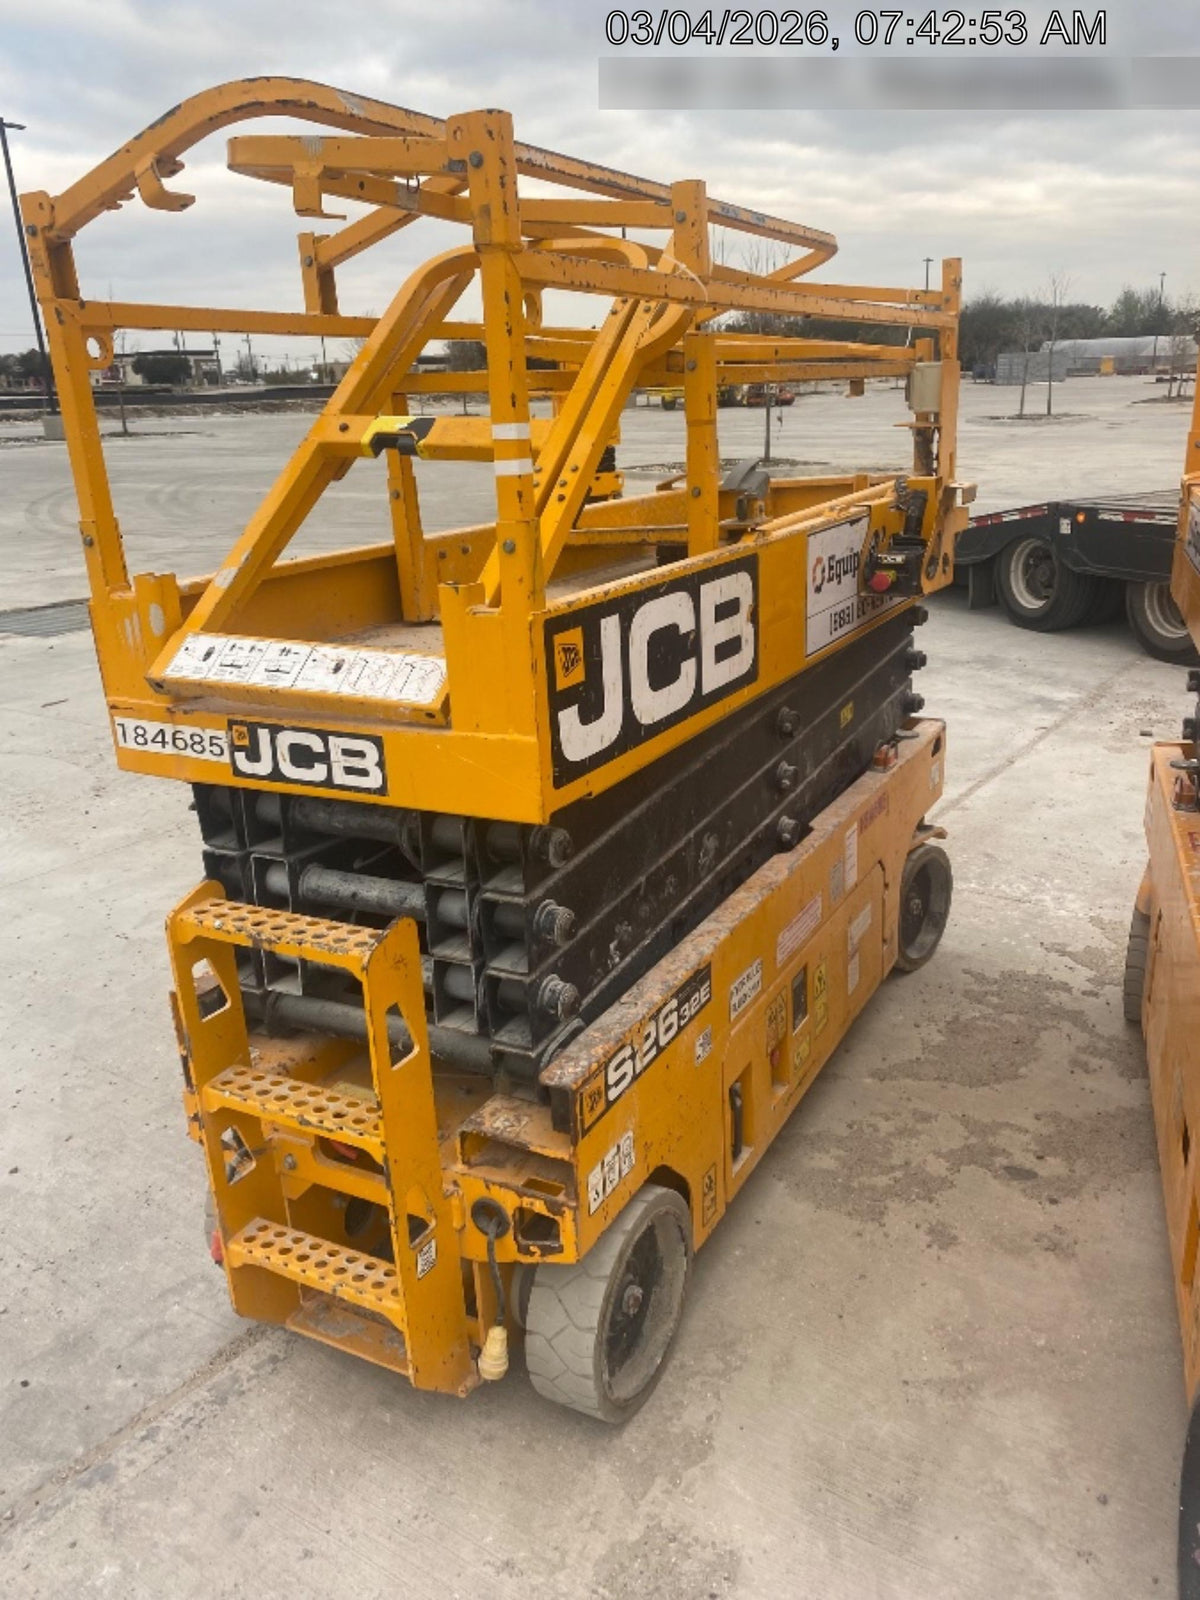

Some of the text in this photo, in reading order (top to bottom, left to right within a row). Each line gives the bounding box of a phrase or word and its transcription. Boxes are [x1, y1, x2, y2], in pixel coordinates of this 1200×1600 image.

[557, 571, 755, 763] JCB
[116, 723, 225, 757] 184685
[234, 728, 383, 789] JCB
